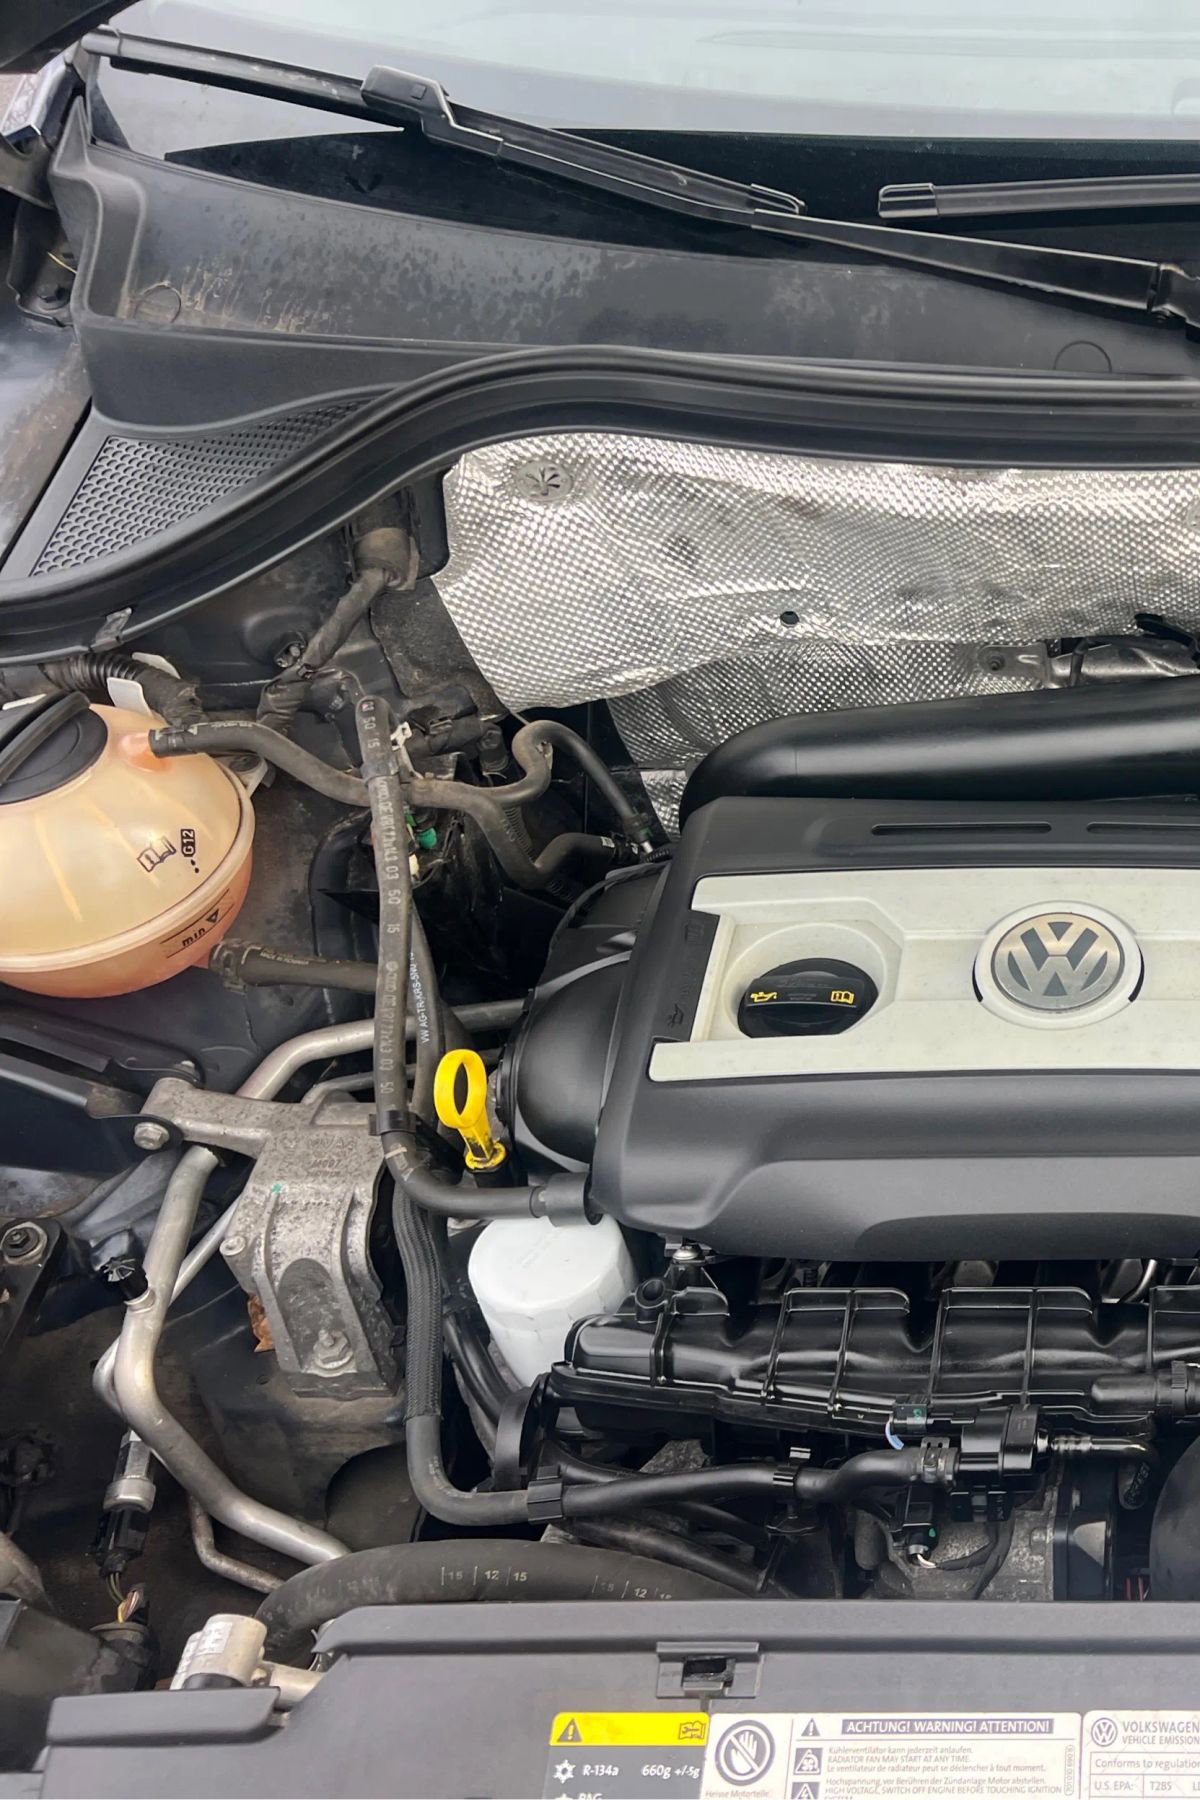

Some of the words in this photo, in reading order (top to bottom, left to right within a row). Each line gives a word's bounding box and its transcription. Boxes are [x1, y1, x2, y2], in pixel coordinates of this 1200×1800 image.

[367, 738, 380, 749] 15
[182, 830, 195, 856] G12
[386, 866, 399, 880] 03
[388, 889, 400, 905] 50
[387, 923, 400, 933] 15
[182, 928, 205, 946] min
[485, 1570, 499, 1580] 12
[514, 1572, 528, 1582] 15
[635, 1588, 648, 1598] 12
[847, 1721, 910, 1732] ACHTUNG!
[914, 1721, 976, 1732] WARNING!
[979, 1721, 1050, 1732] ATTENTION!
[1122, 1721, 1200, 1733] VOLKSWAGEN
[1122, 1736, 1156, 1745] VEHICLE
[1159, 1736, 1200, 1745] EMISSION
[888, 1746, 906, 1754] kann
[1095, 1759, 1140, 1768] Conforms
[1143, 1759, 1152, 1768] to
[582, 1765, 619, 1776] R-134a
[642, 1765, 671, 1779] 660g
[674, 1765, 700, 1778] +/-5g
